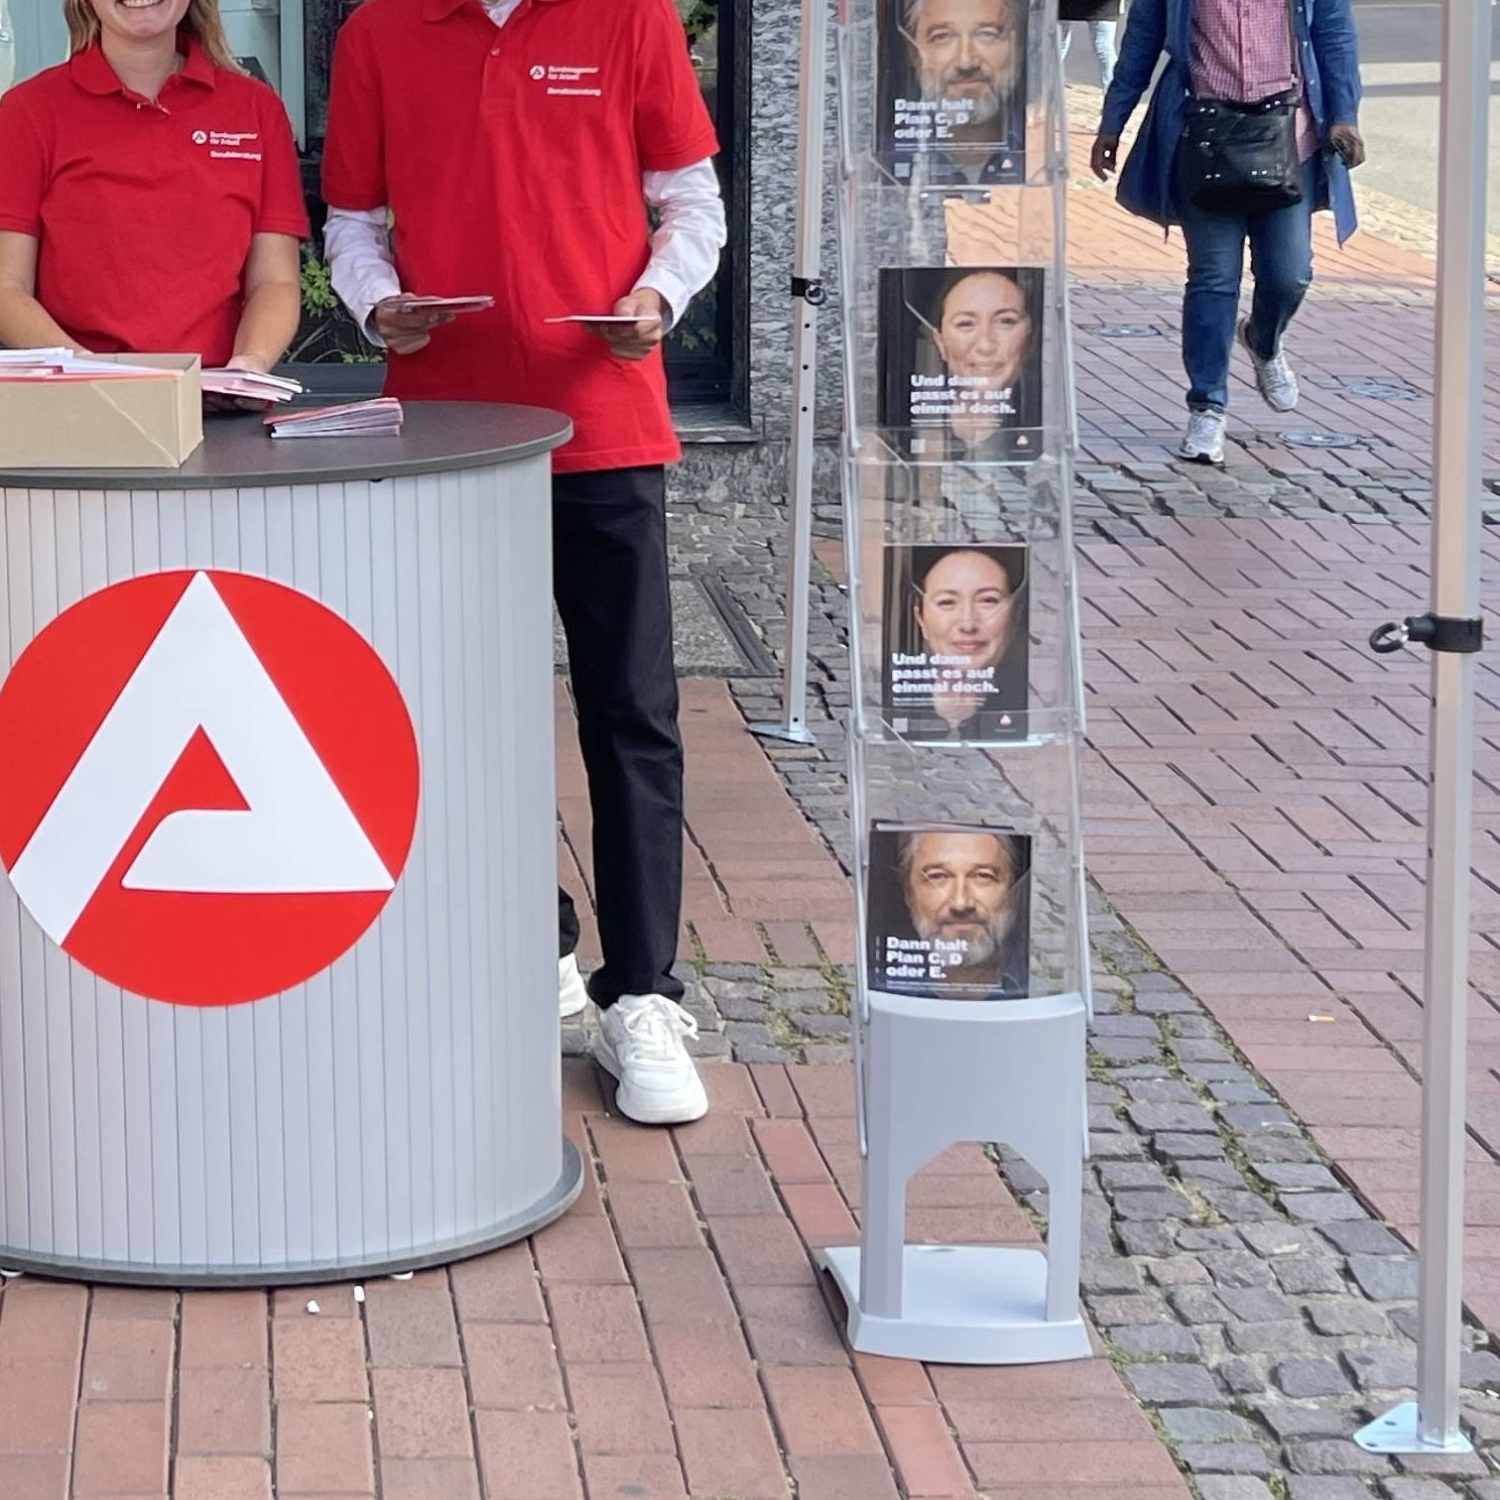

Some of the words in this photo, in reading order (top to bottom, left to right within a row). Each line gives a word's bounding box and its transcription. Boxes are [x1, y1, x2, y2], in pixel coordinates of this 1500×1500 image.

[894, 98, 938, 111] Dann
[941, 98, 975, 110] halt
[894, 112, 932, 125] Plan
[955, 111, 970, 124] D
[894, 127, 933, 139] oder
[935, 126, 954, 138] E.
[910, 374, 945, 387] Und
[910, 389, 957, 403] passt
[959, 390, 980, 400] es
[983, 387, 1012, 400] auf
[910, 401, 966, 414] einmal
[969, 401, 1016, 414] doch.
[892, 652, 927, 665] Und
[892, 668, 939, 682] passt
[942, 669, 963, 679] es
[966, 666, 995, 679] auf
[892, 681, 949, 693] einmal
[952, 681, 999, 693] doch.
[886, 936, 931, 951] Dann
[934, 938, 969, 952] halt
[886, 950, 925, 964] Plan
[928, 952, 946, 967] C,
[949, 953, 963, 966] D
[886, 964, 926, 978] oder
[929, 966, 947, 979] E.
